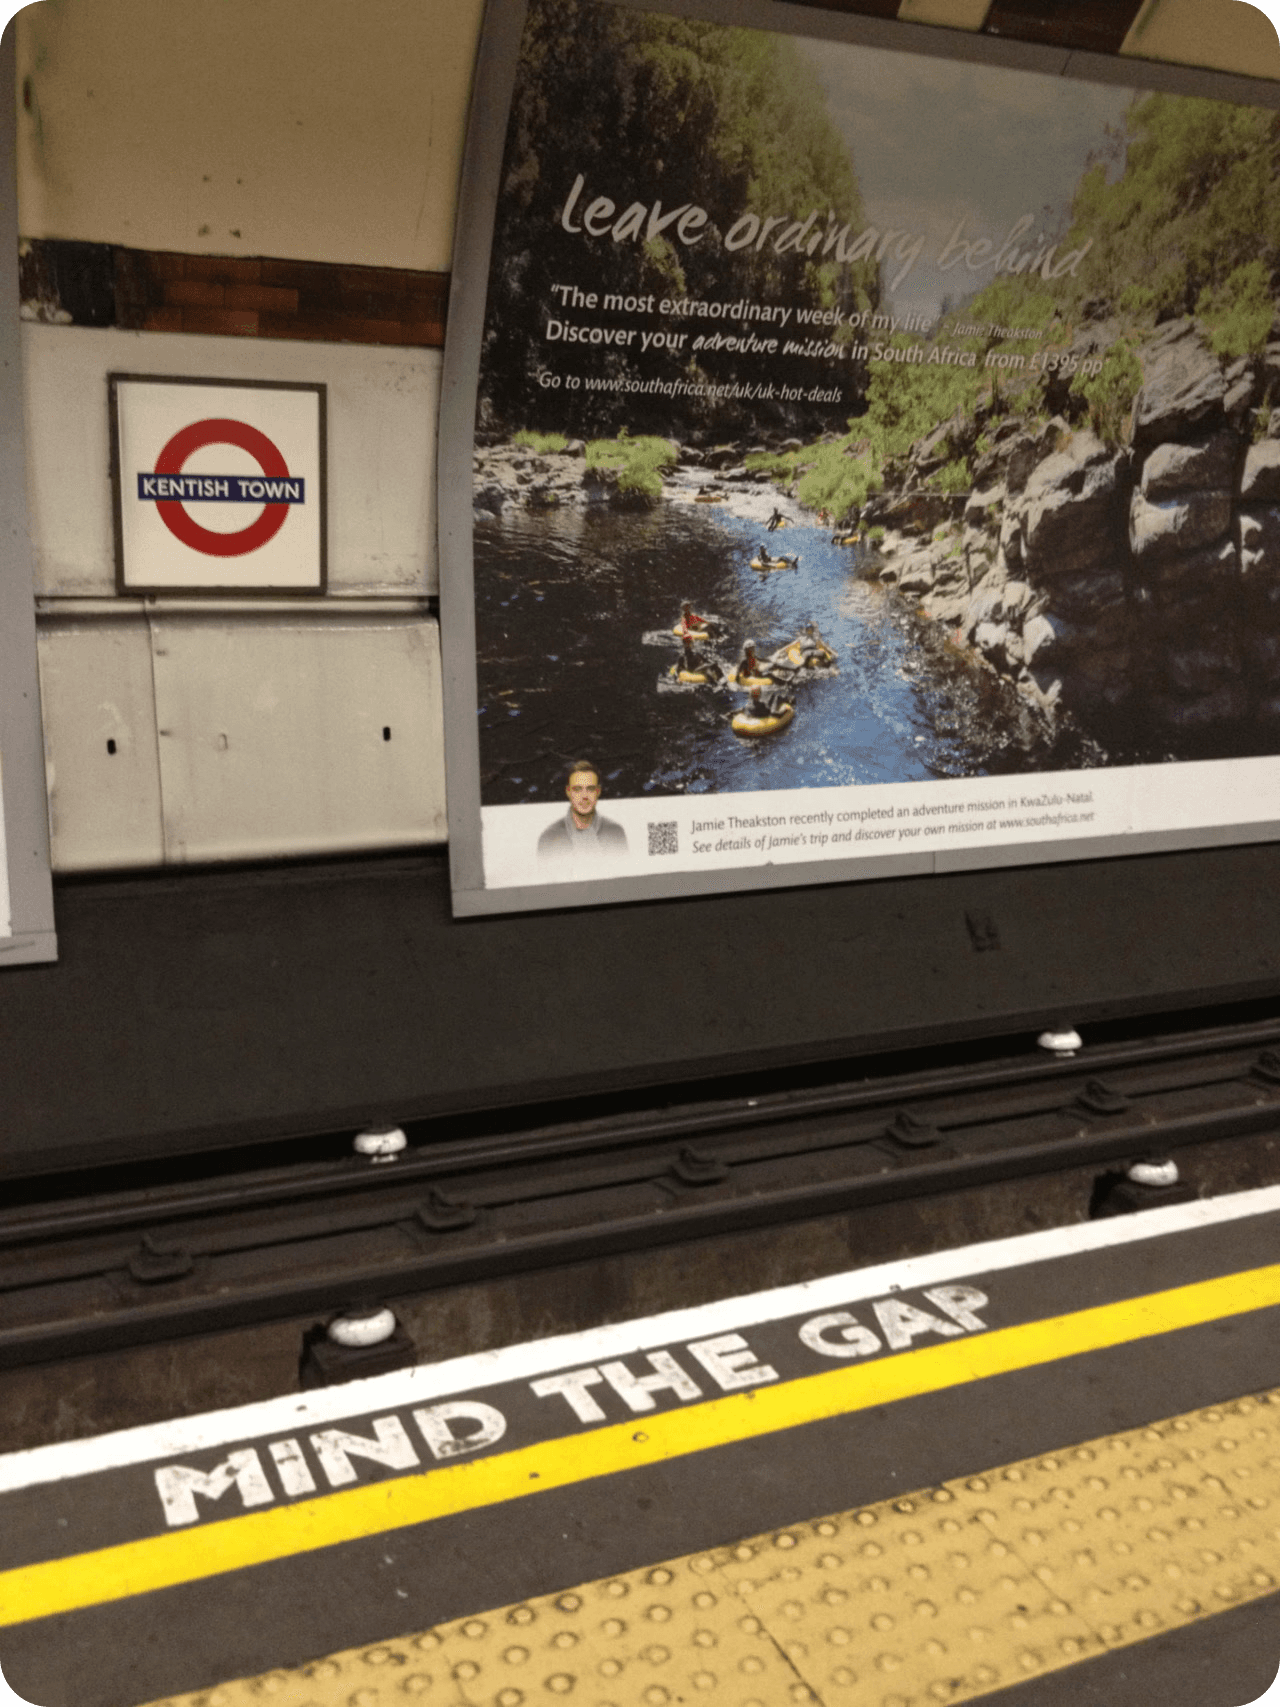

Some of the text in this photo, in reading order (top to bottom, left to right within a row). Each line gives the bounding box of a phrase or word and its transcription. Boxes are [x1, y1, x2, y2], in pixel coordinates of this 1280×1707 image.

[724, 209, 925, 292] ordinary
[938, 214, 1094, 280] behind
[603, 293, 655, 314] most
[659, 298, 792, 327] extraordinary
[796, 306, 843, 326] week
[849, 310, 871, 329] of
[872, 314, 900, 335] my
[988, 324, 1043, 339] Theakston
[546, 320, 637, 346] Discover
[641, 332, 688, 352] your
[692, 331, 778, 355] adventure
[782, 337, 845, 359] mission
[851, 340, 869, 361] in
[872, 342, 922, 364] South
[927, 345, 977, 367] Africa
[984, 350, 1025, 370] from
[1081, 359, 1103, 378] pp
[539, 371, 843, 403] Go to www.southafrica.net/uk/uk-hot-deals
[143, 477, 300, 499] KENTISH TOWN
[690, 819, 725, 835] Jamie
[727, 814, 786, 830] Theakston
[789, 810, 834, 826] recently
[836, 806, 894, 823] completed
[897, 806, 910, 818] an
[912, 803, 965, 817] adventure
[967, 799, 1006, 812] mission
[1008, 797, 1018, 809] in
[692, 840, 712, 853] See
[715, 836, 751, 852] details
[754, 835, 767, 851] of
[810, 831, 828, 847] trip
[831, 829, 852, 843] and
[854, 827, 896, 842] discover
[898, 826, 922, 841] your
[924, 823, 946, 836] own
[948, 820, 984, 834] mission
[986, 819, 997, 831] at
[999, 811, 1096, 829] www.southafrica.net
[154, 1286, 991, 1527] MIND THE GAP
